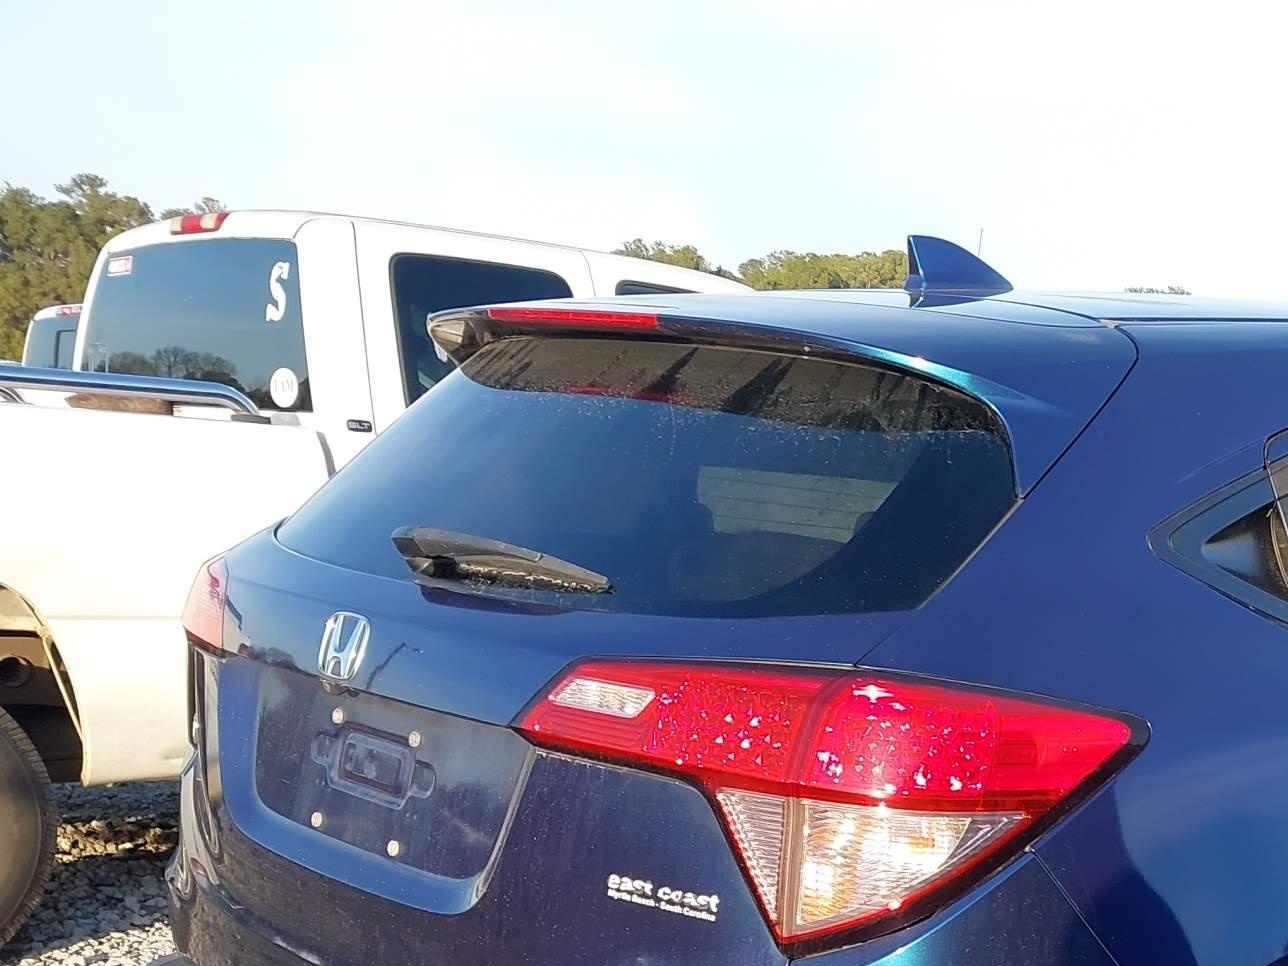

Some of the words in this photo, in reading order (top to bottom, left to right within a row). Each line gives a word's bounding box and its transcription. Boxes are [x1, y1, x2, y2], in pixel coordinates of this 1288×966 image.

[265, 261, 290, 322] S
[607, 873, 654, 896] east
[656, 886, 720, 913] coast
[607, 888, 632, 902] Myrtle
[631, 895, 656, 907] Beach
[659, 901, 683, 914] South
[682, 907, 717, 922] Carolina
